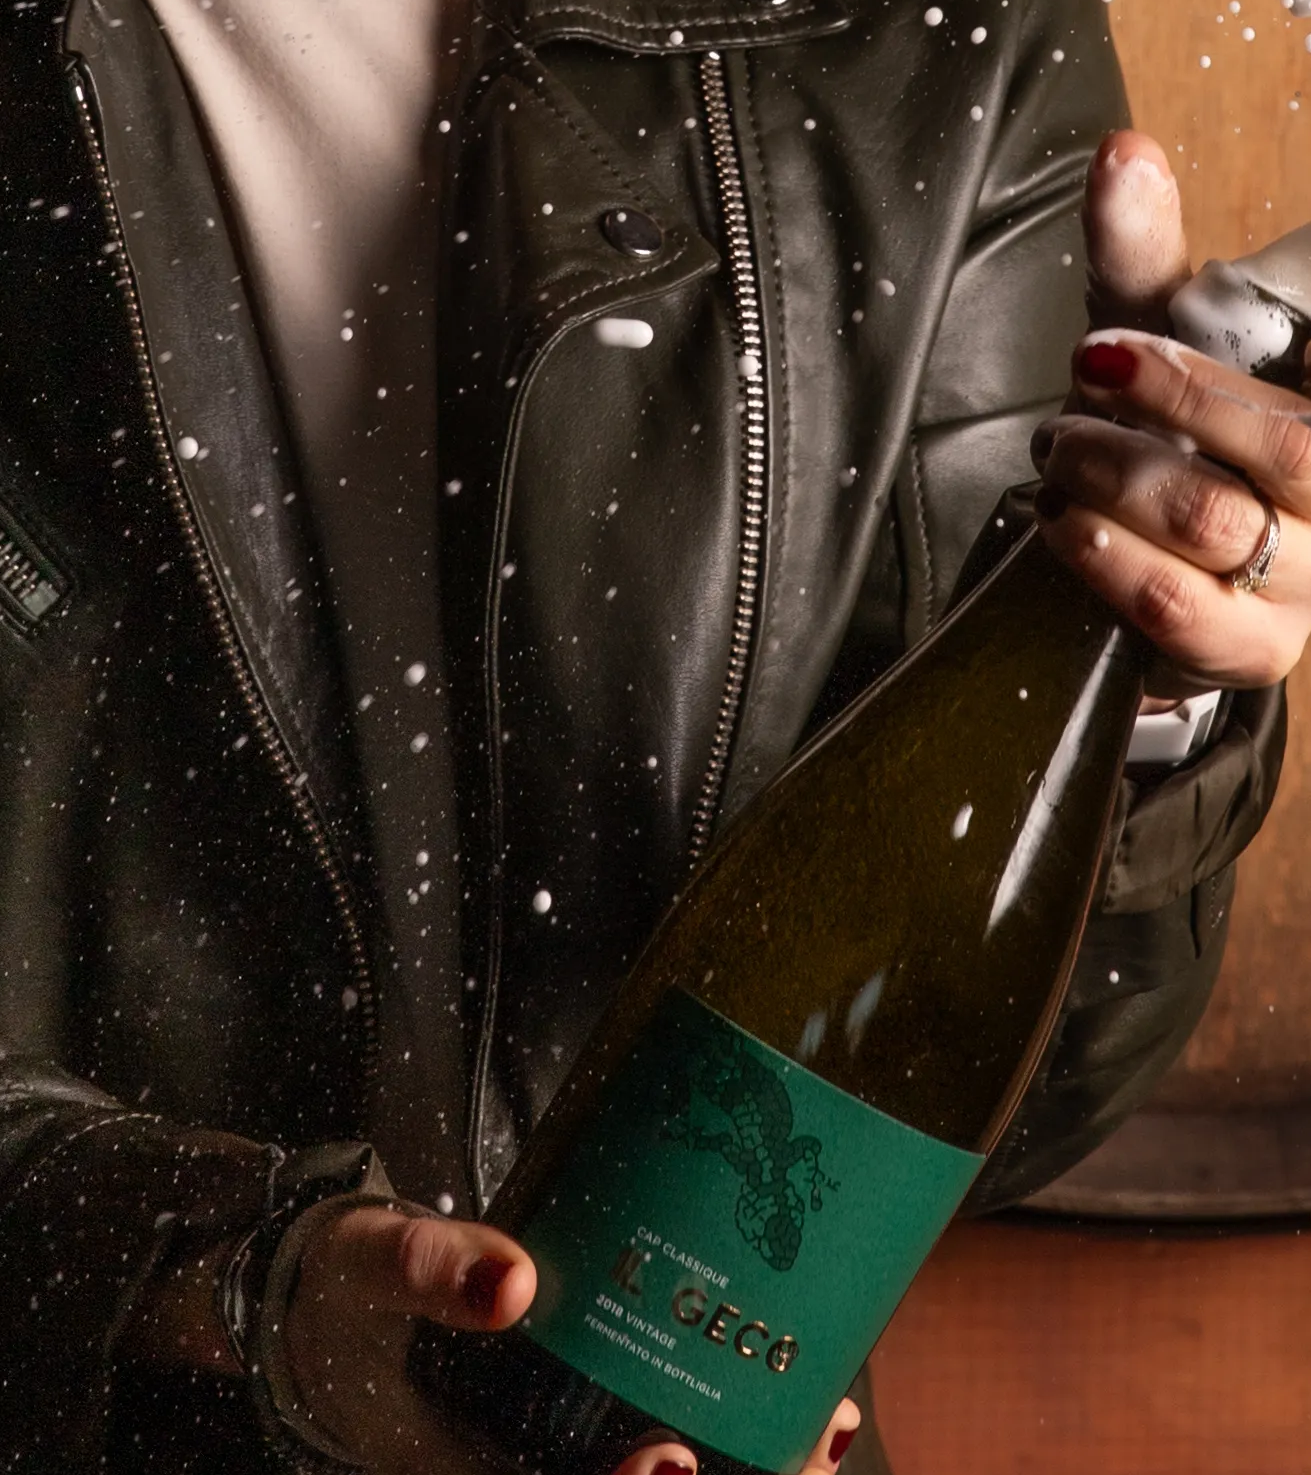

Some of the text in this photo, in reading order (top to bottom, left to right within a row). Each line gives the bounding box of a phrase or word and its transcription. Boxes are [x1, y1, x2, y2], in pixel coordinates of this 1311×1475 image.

[636, 1226, 731, 1290] CAP CLASSIQUE
[584, 1314, 650, 1361] FERMENTATO
[650, 1354, 664, 1370] IN
[626, 1313, 677, 1350] VINTAGE
[672, 1289, 799, 1373] GECO
